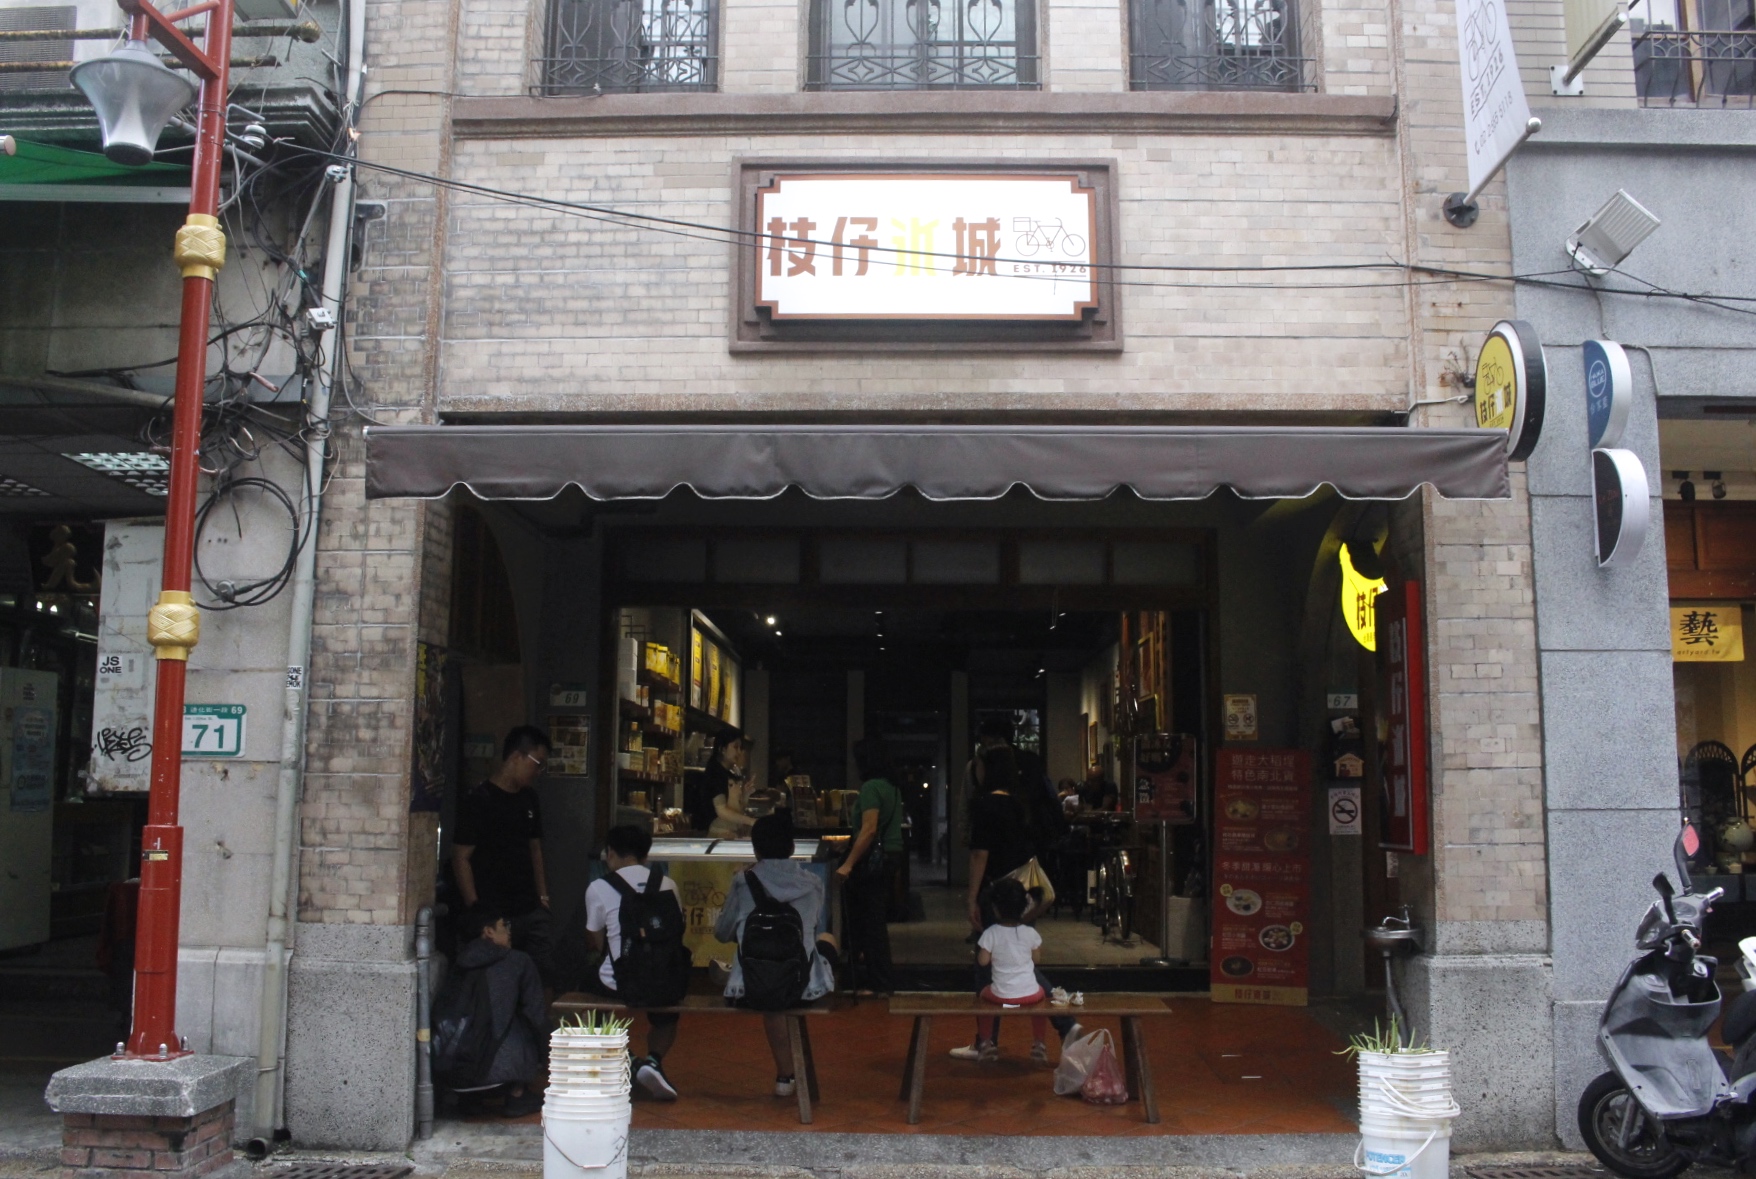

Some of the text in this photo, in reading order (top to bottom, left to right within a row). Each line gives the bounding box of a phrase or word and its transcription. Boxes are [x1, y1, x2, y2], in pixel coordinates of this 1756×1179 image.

[766, 215, 1002, 278] 枝仔冰城
[1013, 262, 1088, 274] EST. 1926
[1679, 610, 1719, 646] 藝
[102, 656, 120, 666] JS
[100, 666, 122, 674] ONE
[564, 693, 580, 704] 69
[1333, 695, 1351, 707] 67
[231, 706, 244, 714] 69
[191, 724, 225, 749] 71
